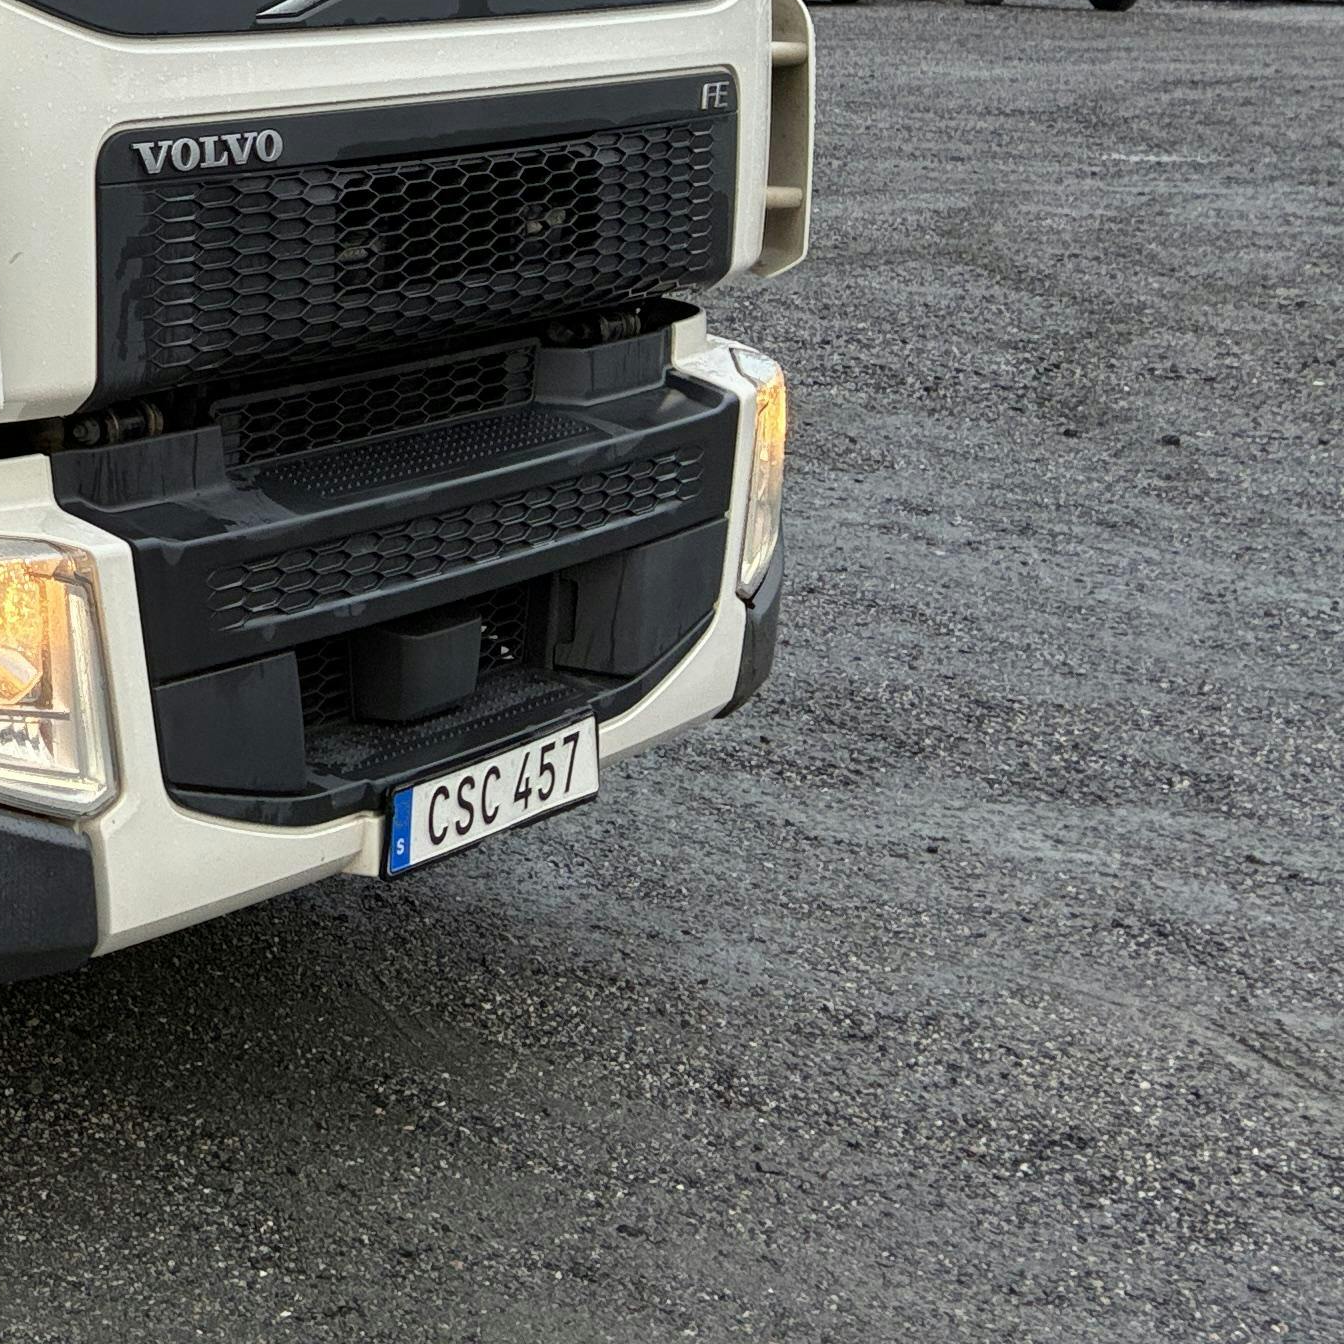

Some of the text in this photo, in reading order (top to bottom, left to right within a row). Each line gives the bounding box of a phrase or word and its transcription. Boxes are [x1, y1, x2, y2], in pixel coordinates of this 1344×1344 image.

[701, 81, 730, 110] FE
[132, 129, 284, 174] VOLVO
[428, 731, 581, 846] CSC 457
[396, 837, 405, 855] S
